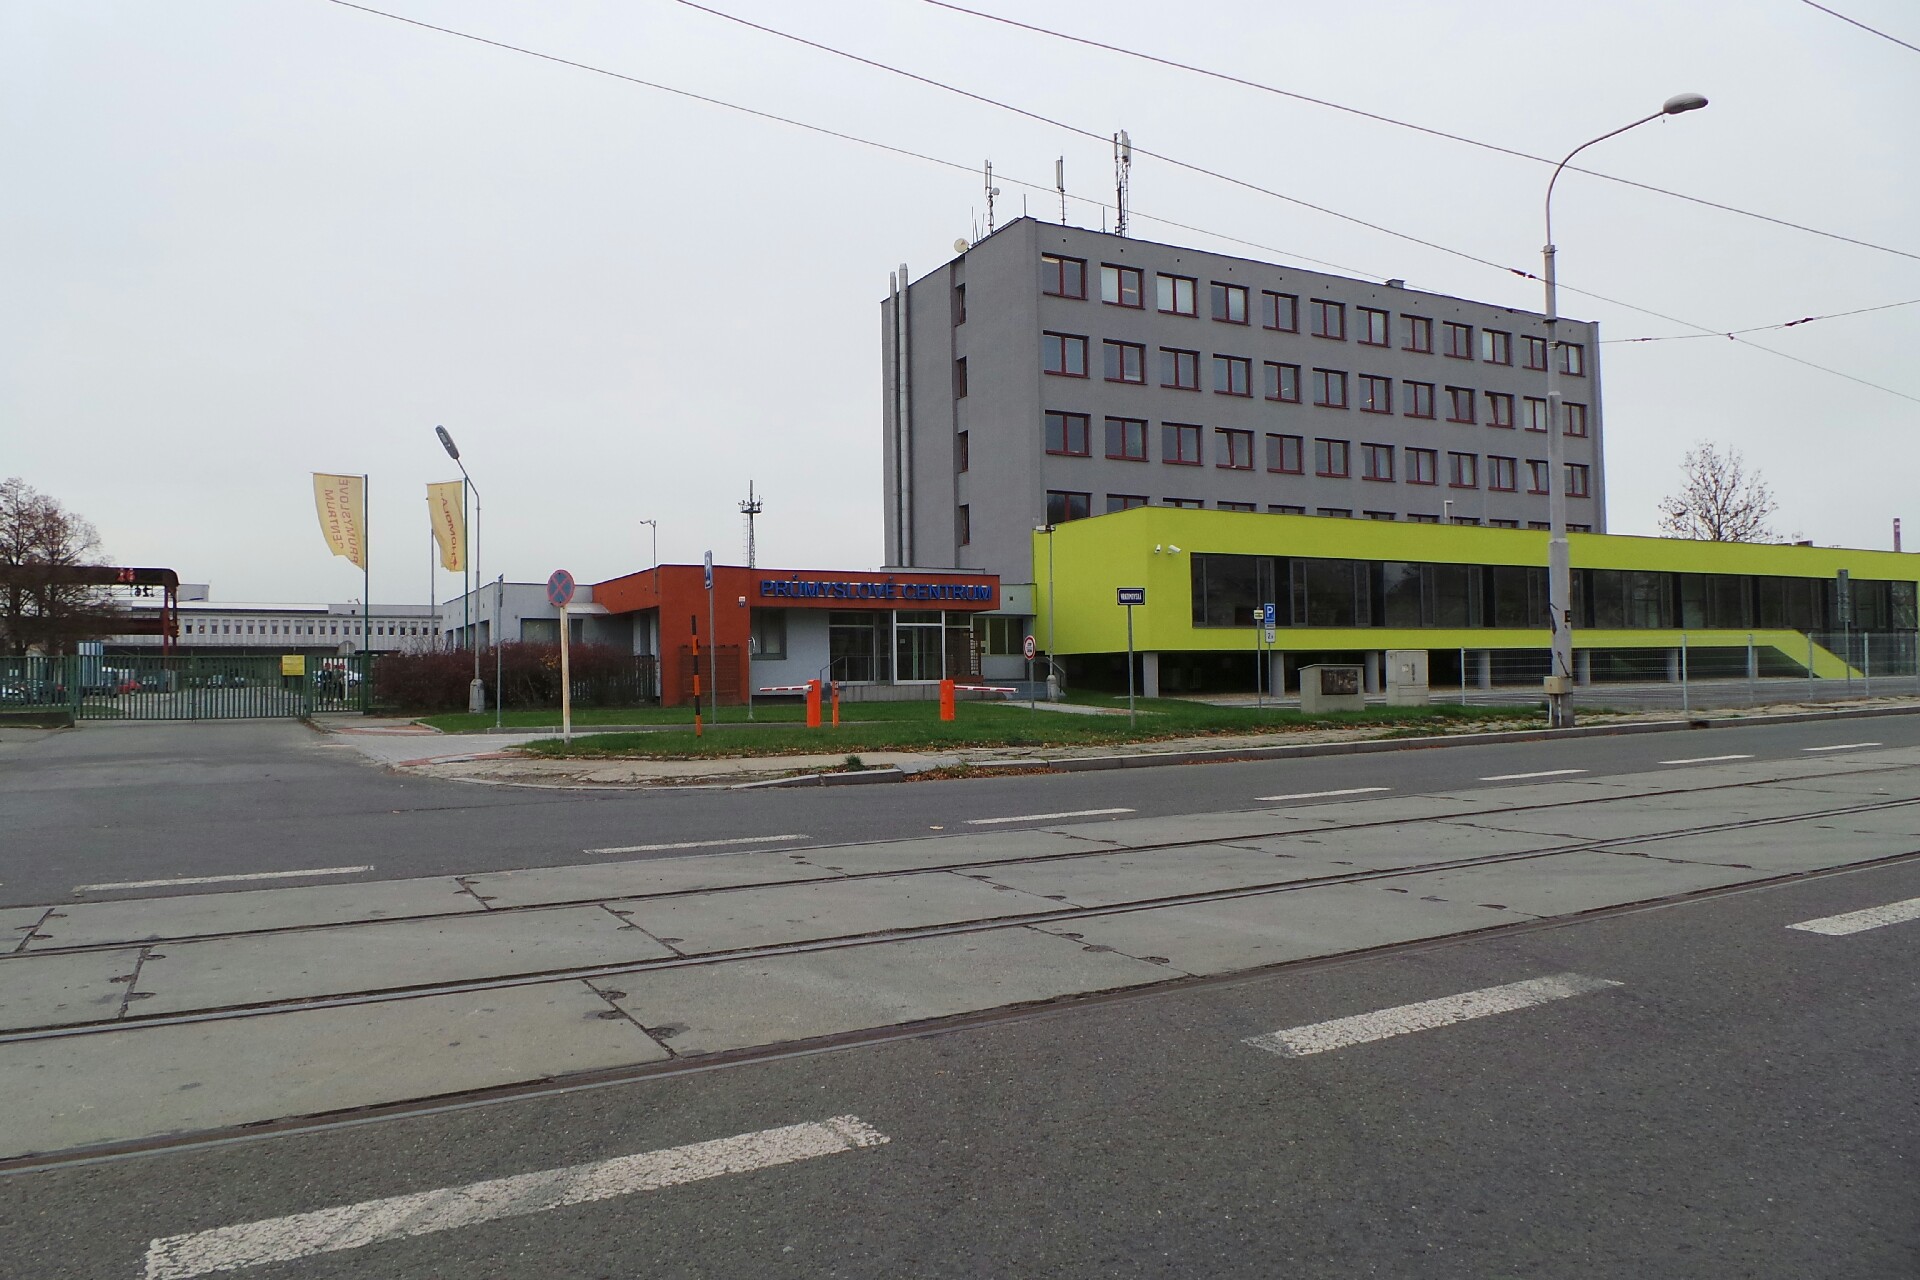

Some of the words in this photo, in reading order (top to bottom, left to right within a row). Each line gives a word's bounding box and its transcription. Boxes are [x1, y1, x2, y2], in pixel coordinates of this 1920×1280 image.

[760, 574, 897, 600] PRŮMYSLOVÉ
[902, 583, 993, 601] CENTRUM
[1266, 606, 1274, 617] P
